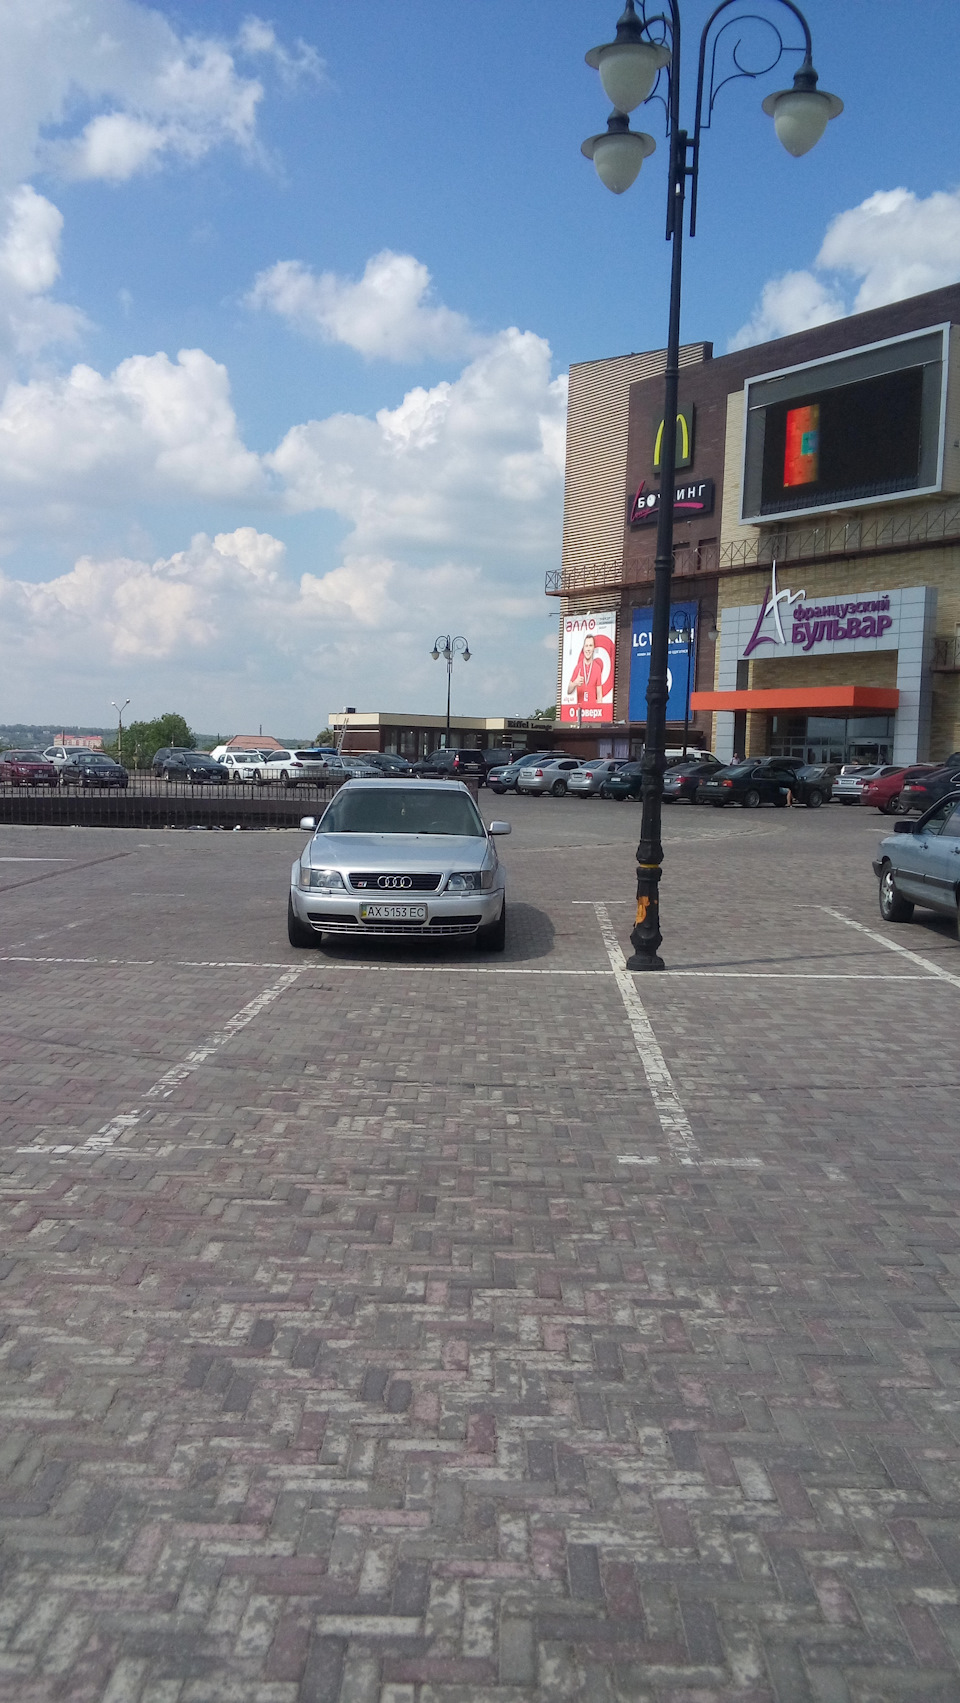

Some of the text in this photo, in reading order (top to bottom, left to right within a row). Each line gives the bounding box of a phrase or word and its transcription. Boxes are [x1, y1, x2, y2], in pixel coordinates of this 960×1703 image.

[637, 484, 706, 509] БОИНГ
[793, 595, 890, 622] французский
[507, 720, 529, 728] Eiffel
[368, 906, 424, 918] AX 5153 EC
